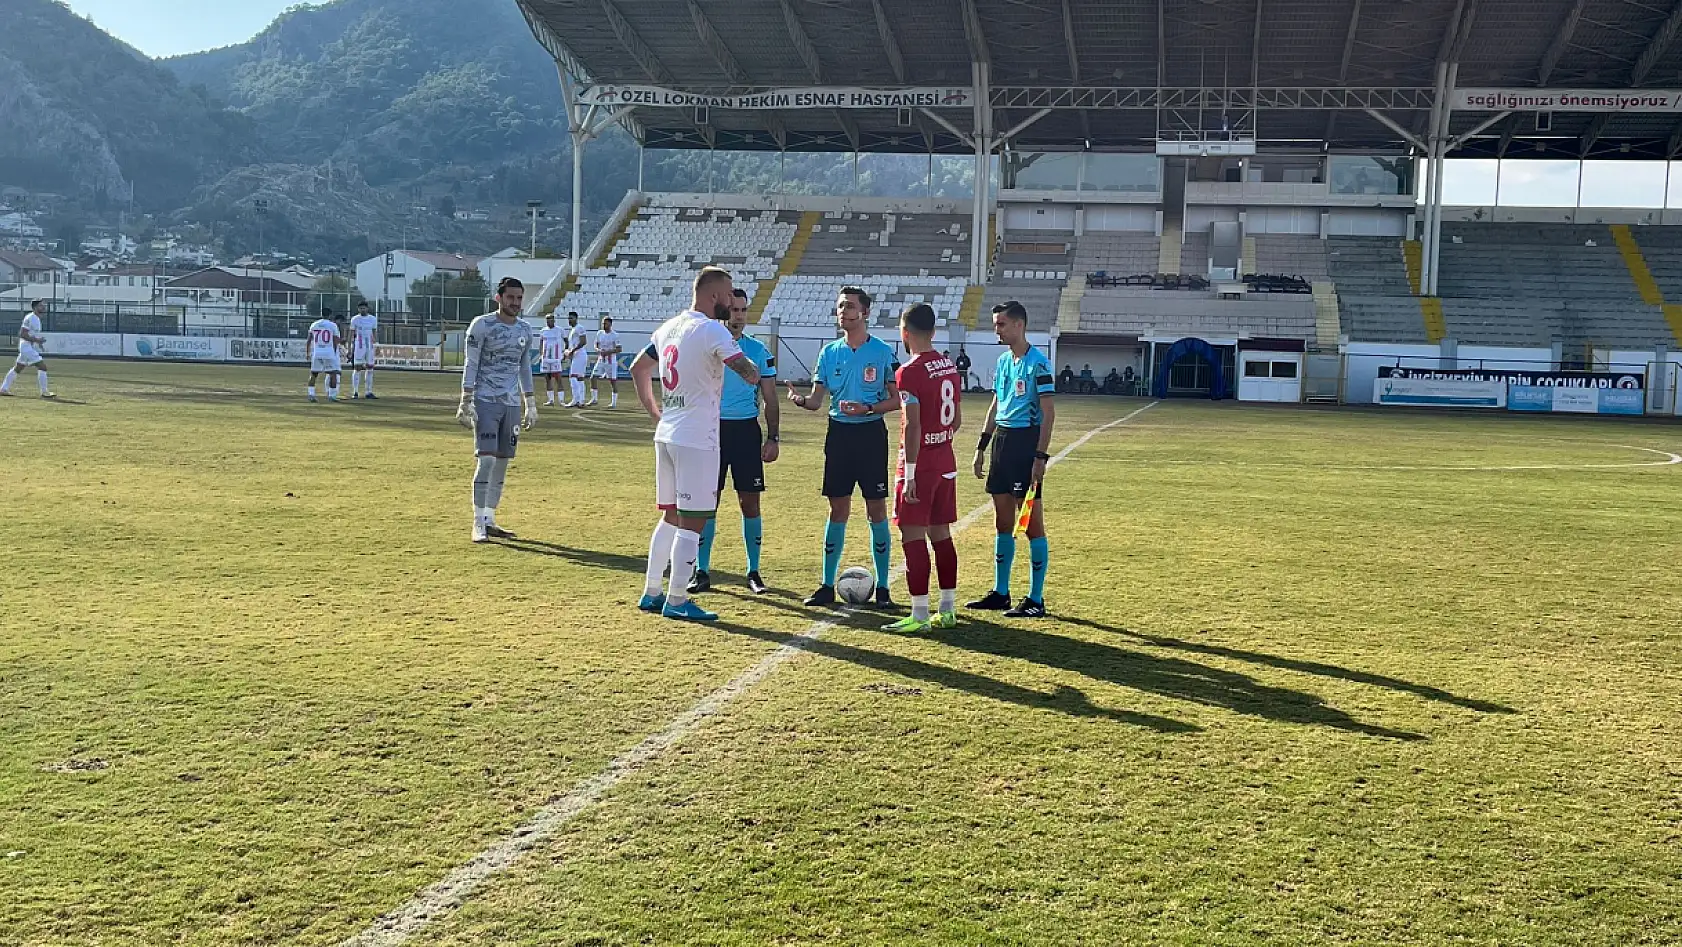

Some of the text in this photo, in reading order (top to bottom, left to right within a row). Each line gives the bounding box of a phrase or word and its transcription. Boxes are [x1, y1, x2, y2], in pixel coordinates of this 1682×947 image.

[621, 87, 660, 104] ÖZEL
[665, 93, 733, 107] LOKMAN
[738, 92, 790, 108] HEKİM
[795, 93, 846, 106] ESNAF
[851, 90, 939, 106] HASTANESİ
[1467, 93, 1554, 108] sağlığınızı
[1560, 93, 1668, 109] önemsiyoruz
[156, 337, 212, 350] Baransel
[313, 329, 331, 343] 70
[662, 344, 679, 391] 3
[940, 379, 955, 426] 8
